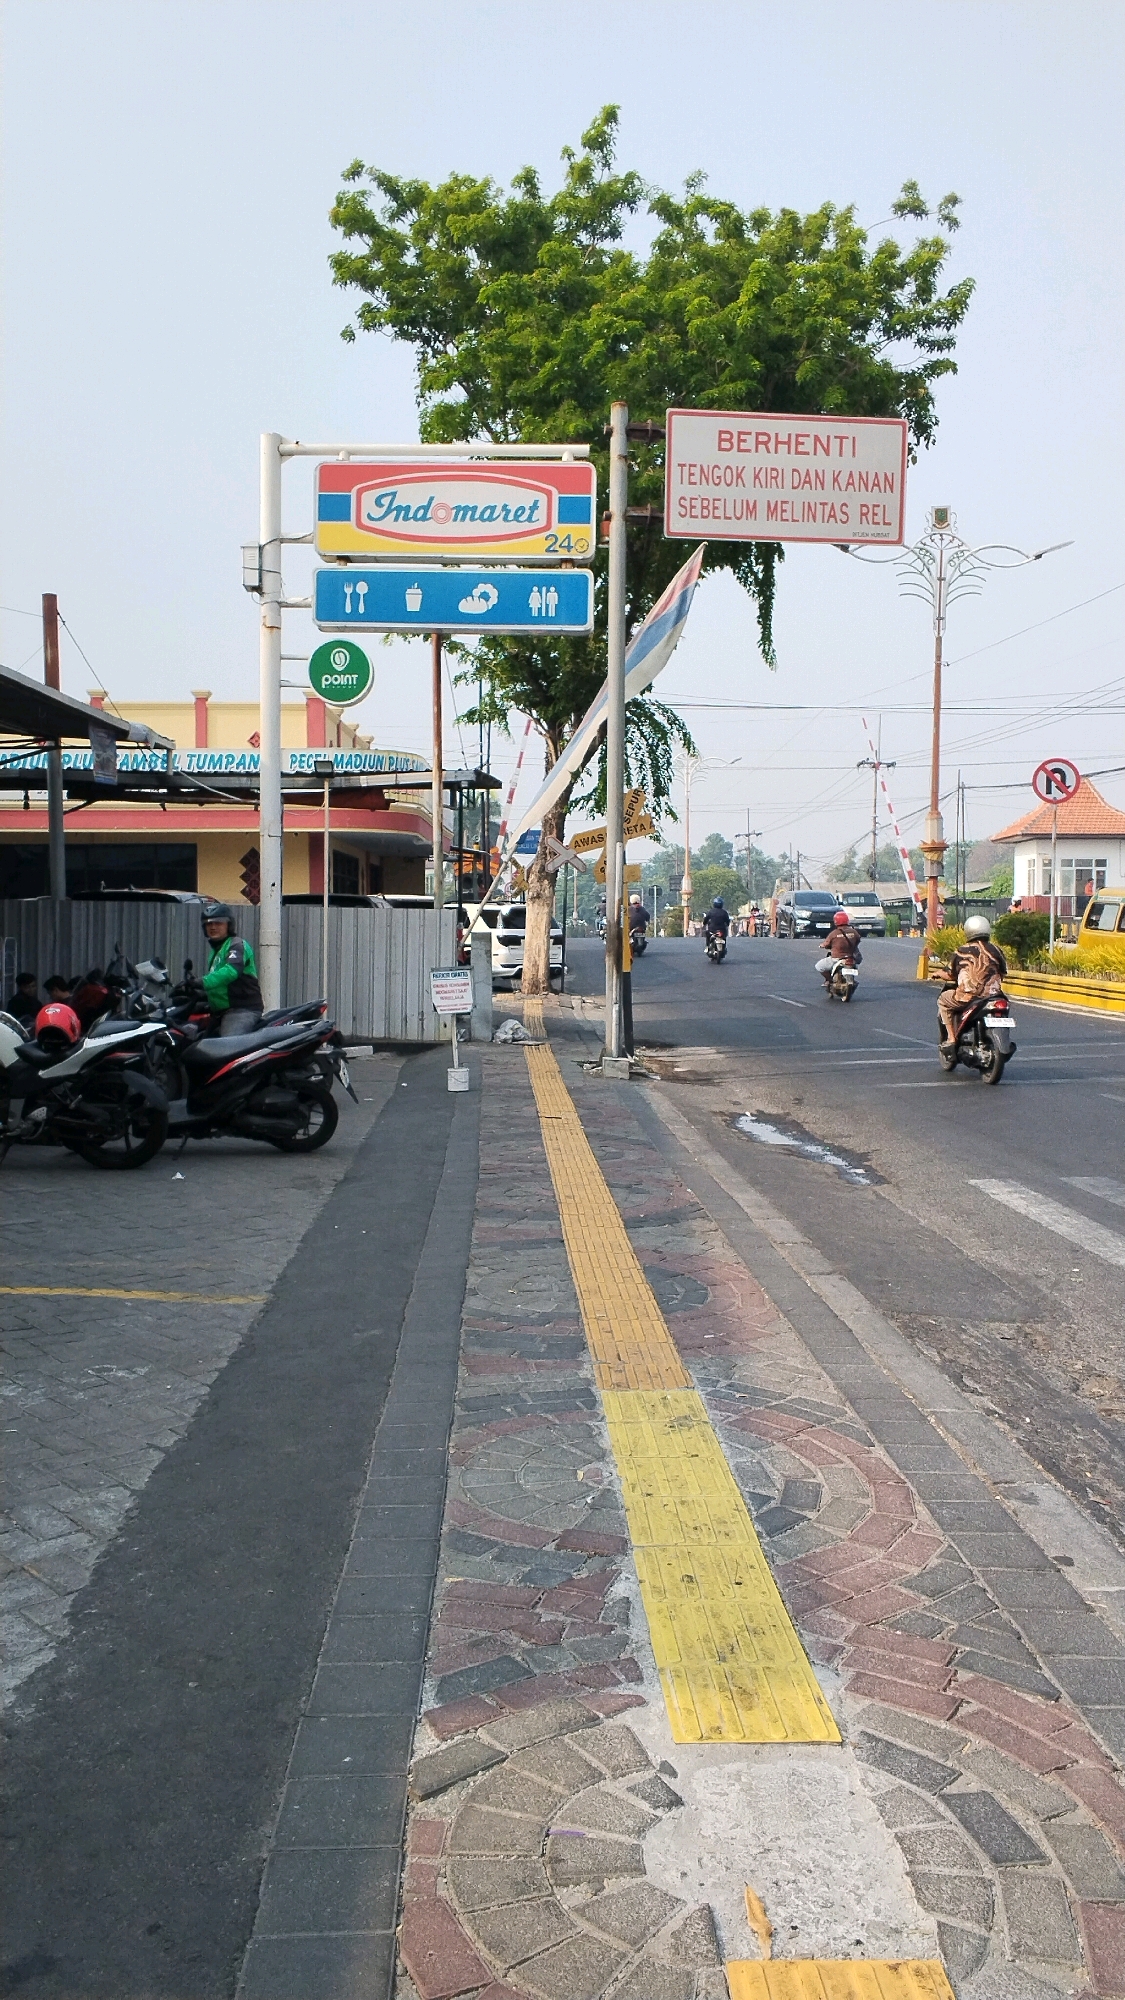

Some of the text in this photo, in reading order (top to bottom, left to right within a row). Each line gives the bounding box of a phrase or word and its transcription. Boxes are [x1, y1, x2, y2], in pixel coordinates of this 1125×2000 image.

[717, 429, 857, 458] BERHENTI
[677, 462, 895, 494] TENGOK KIRI DAN KANAN
[366, 490, 540, 524] Indomaret
[677, 496, 892, 526] SEBELUM MELINTAS REL
[544, 533, 574, 553] 24
[62, 753, 94, 769] PLU
[119, 753, 179, 770] AMBEL
[187, 753, 260, 770] TUMPAN
[289, 753, 329, 769] PEC
[333, 753, 385, 769] MADIUN
[624, 788, 642, 824] SEPUR
[574, 833, 605, 848] AWAS
